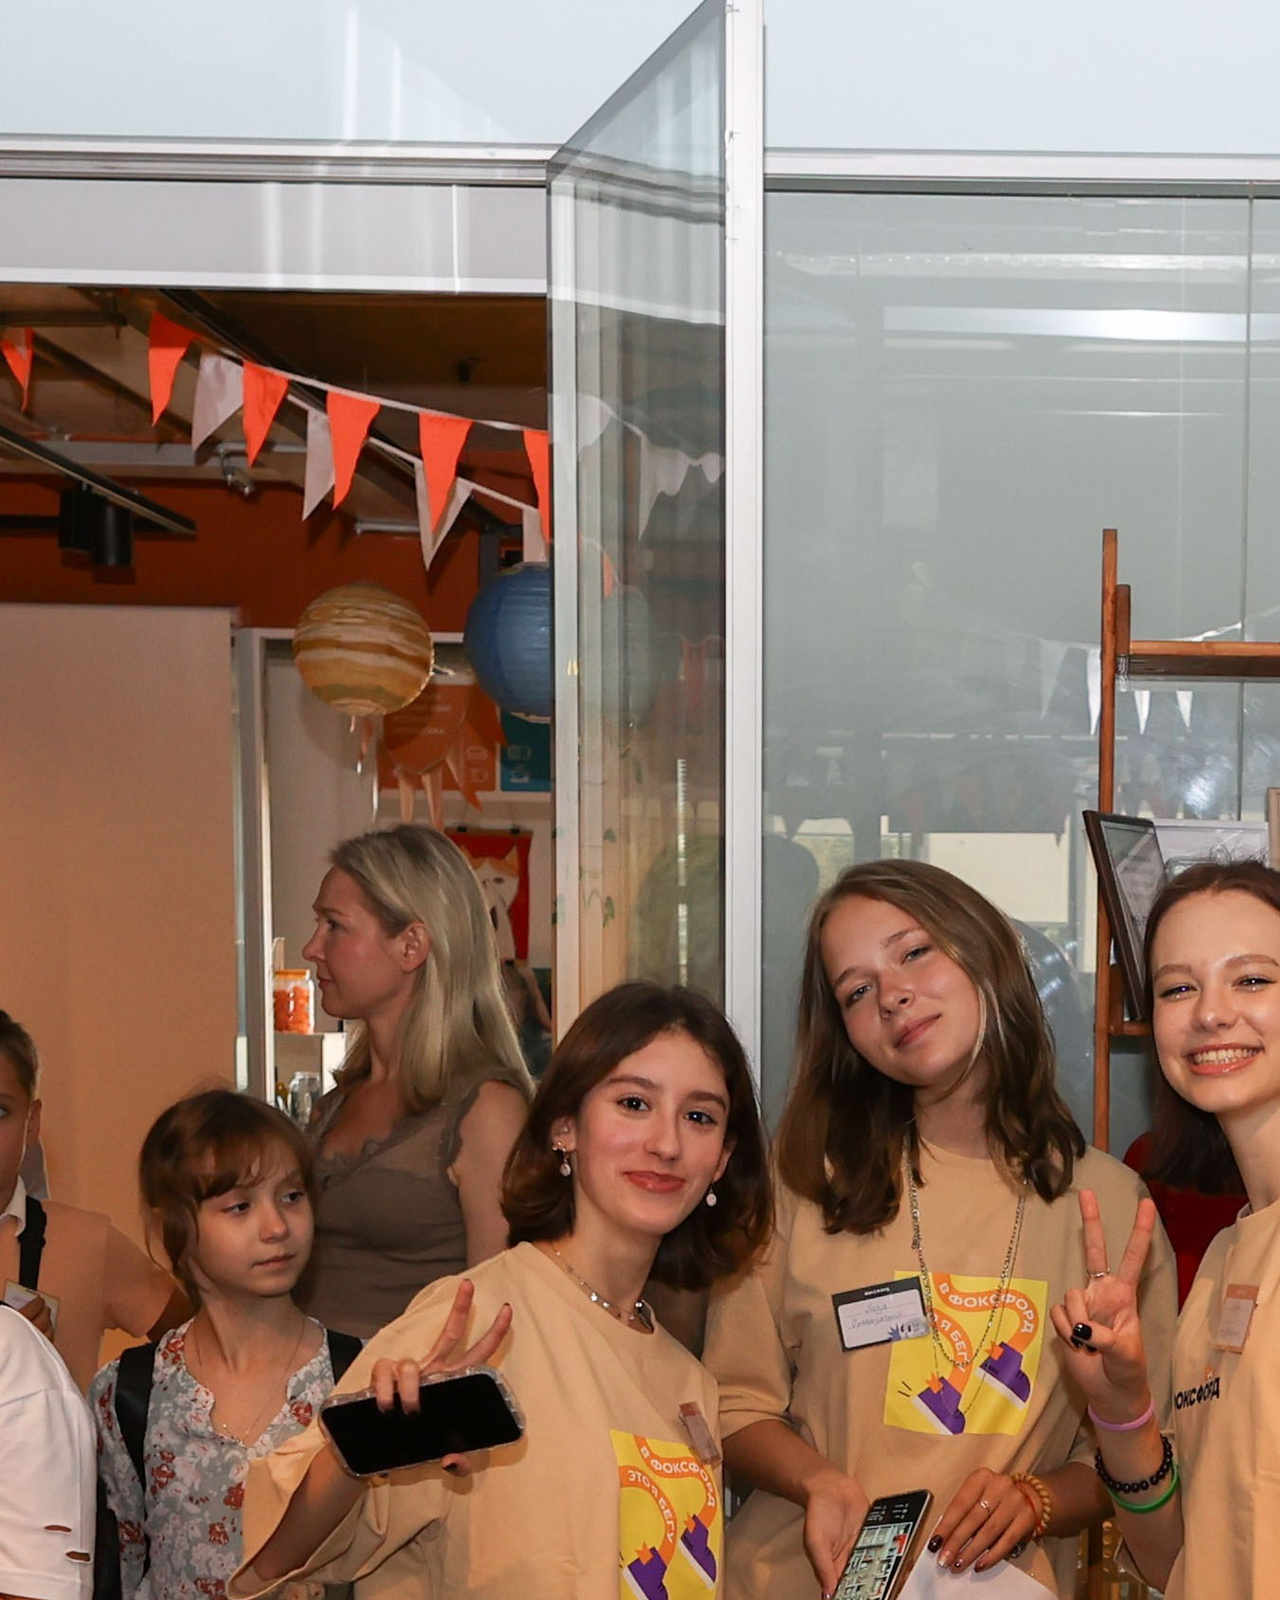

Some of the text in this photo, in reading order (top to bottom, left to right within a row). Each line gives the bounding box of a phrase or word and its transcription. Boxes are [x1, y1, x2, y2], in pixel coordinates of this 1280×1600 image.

[939, 1282, 949, 1294] В
[940, 1319, 952, 1332] Я
[650, 1458, 716, 1508] ФОКСФОРД
[627, 1469, 676, 1543] ЭТО Я БЕГУ
